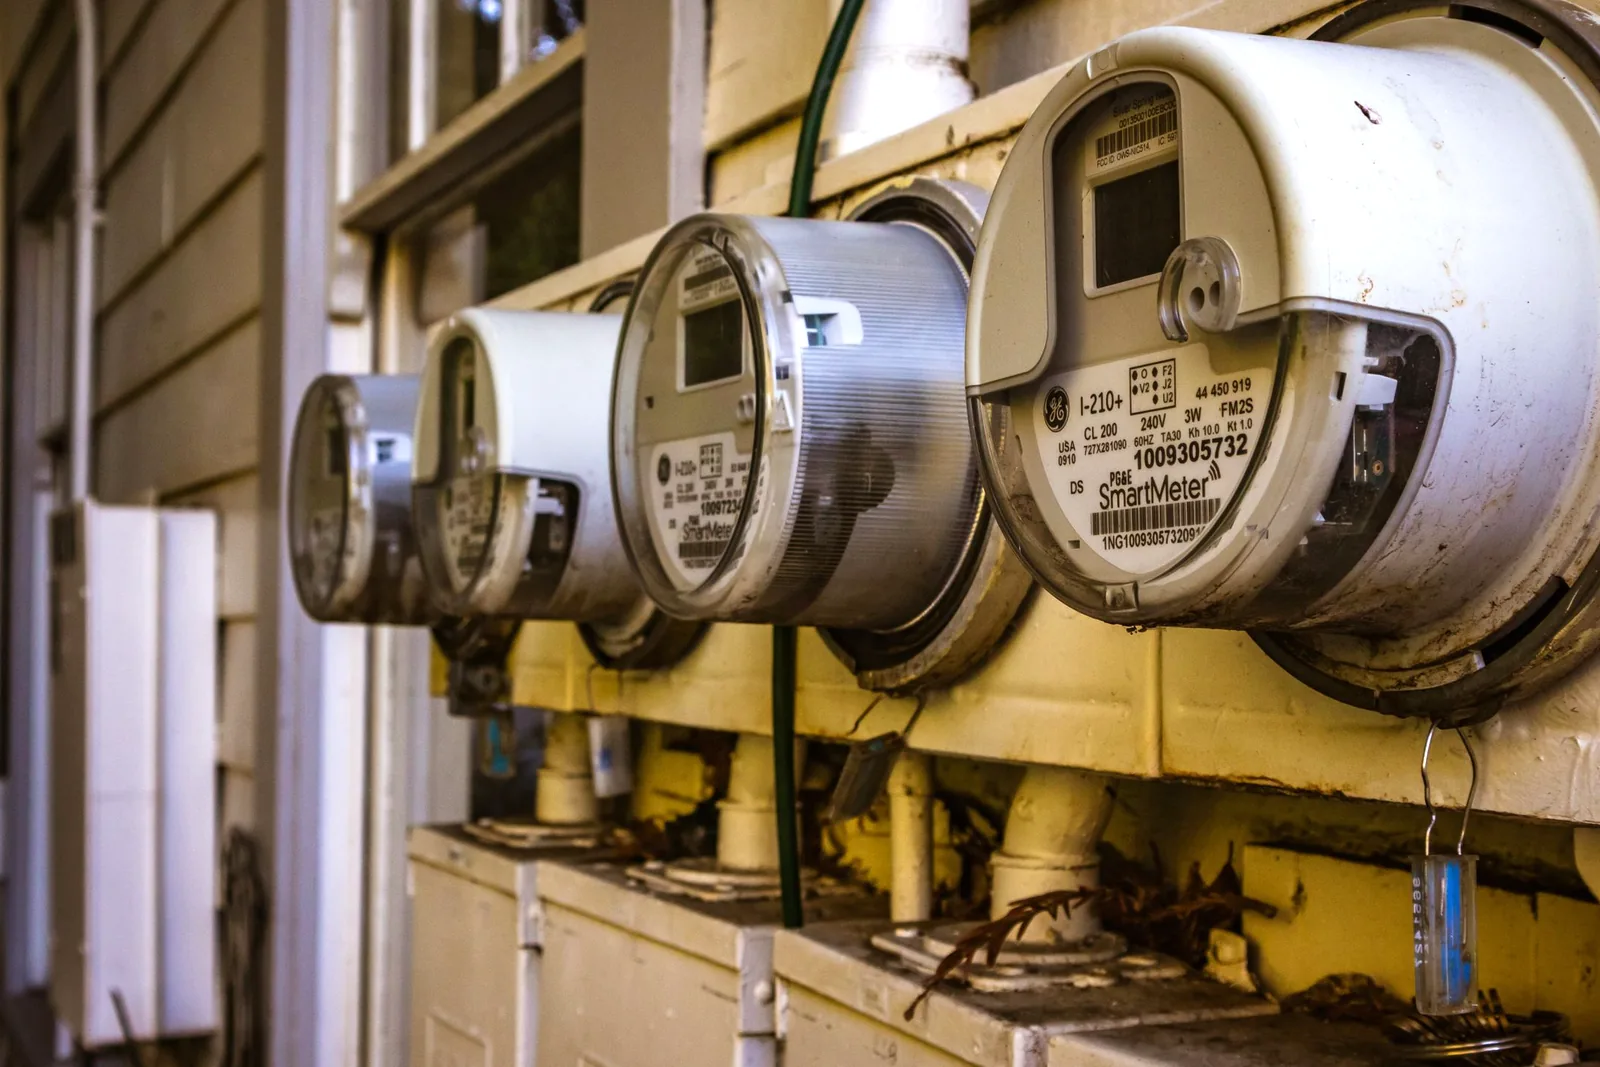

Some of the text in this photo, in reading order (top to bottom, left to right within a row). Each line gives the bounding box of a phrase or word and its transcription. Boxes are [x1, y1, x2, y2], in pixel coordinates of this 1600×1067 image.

[1162, 365, 1172, 376] F2
[1140, 382, 1150, 394] V2
[1195, 377, 1252, 400] 44 450 919
[1080, 390, 1123, 416] I-210+
[1163, 392, 1174, 404] U2
[1084, 397, 1254, 441] CL 200 240V 3W FM2S
[1161, 430, 1181, 443] TA30
[1188, 427, 1200, 438] Kh
[1203, 423, 1220, 436] 10.0
[1227, 420, 1237, 432] Kt
[1240, 418, 1253, 430] 1.0
[1058, 440, 1076, 453] USA
[1134, 433, 1248, 470] 1009305732
[1058, 453, 1076, 466] 0910
[1070, 480, 1084, 494] DS
[1109, 469, 1132, 487] PG&E
[1099, 474, 1209, 510] SmartMeter
